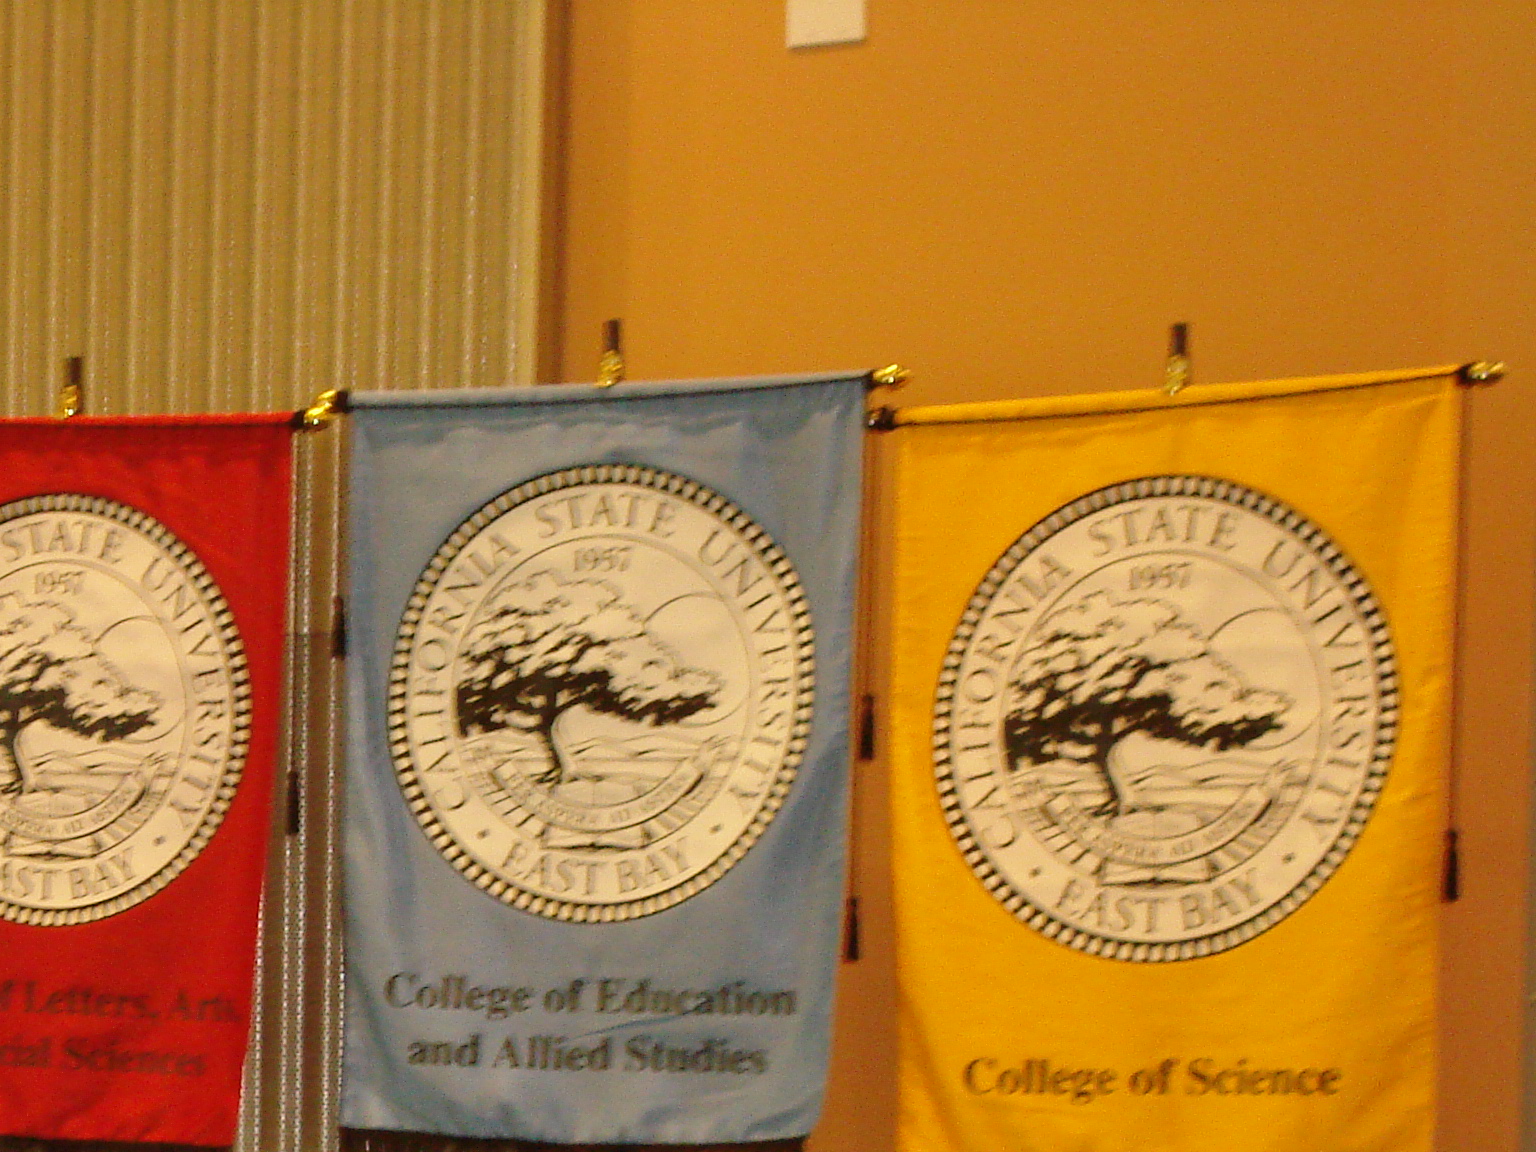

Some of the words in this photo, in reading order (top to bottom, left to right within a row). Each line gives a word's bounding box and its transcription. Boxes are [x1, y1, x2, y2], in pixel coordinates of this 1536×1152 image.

[34, 570, 88, 596] 1957
[572, 546, 634, 573] 1957
[1128, 561, 1193, 591] 1957
[1, 519, 124, 564] STATE
[141, 555, 226, 830] UNIVERSITY
[413, 532, 521, 811] CALIFORNIA
[535, 491, 677, 540] STATE
[697, 528, 789, 818] UNIVERSITY
[958, 553, 1074, 850] CALIFORNIA
[1088, 504, 1241, 558] STATE
[1262, 541, 1368, 846] UNIVERSITY
[69, 846, 137, 901] BAY
[500, 840, 608, 895] EAST
[615, 838, 693, 895] BAY
[1055, 877, 1167, 934] EAST
[1181, 868, 1263, 932] BAY
[383, 971, 534, 1020] College
[542, 977, 588, 1014] of
[595, 978, 798, 1017] Education
[63, 1036, 207, 1077] Sciences
[407, 1033, 482, 1069] and
[492, 1035, 613, 1072] Allied
[624, 1034, 770, 1075] Studies
[964, 1055, 1118, 1106] College
[1128, 1057, 1181, 1096] of
[1186, 1056, 1343, 1096] Science
